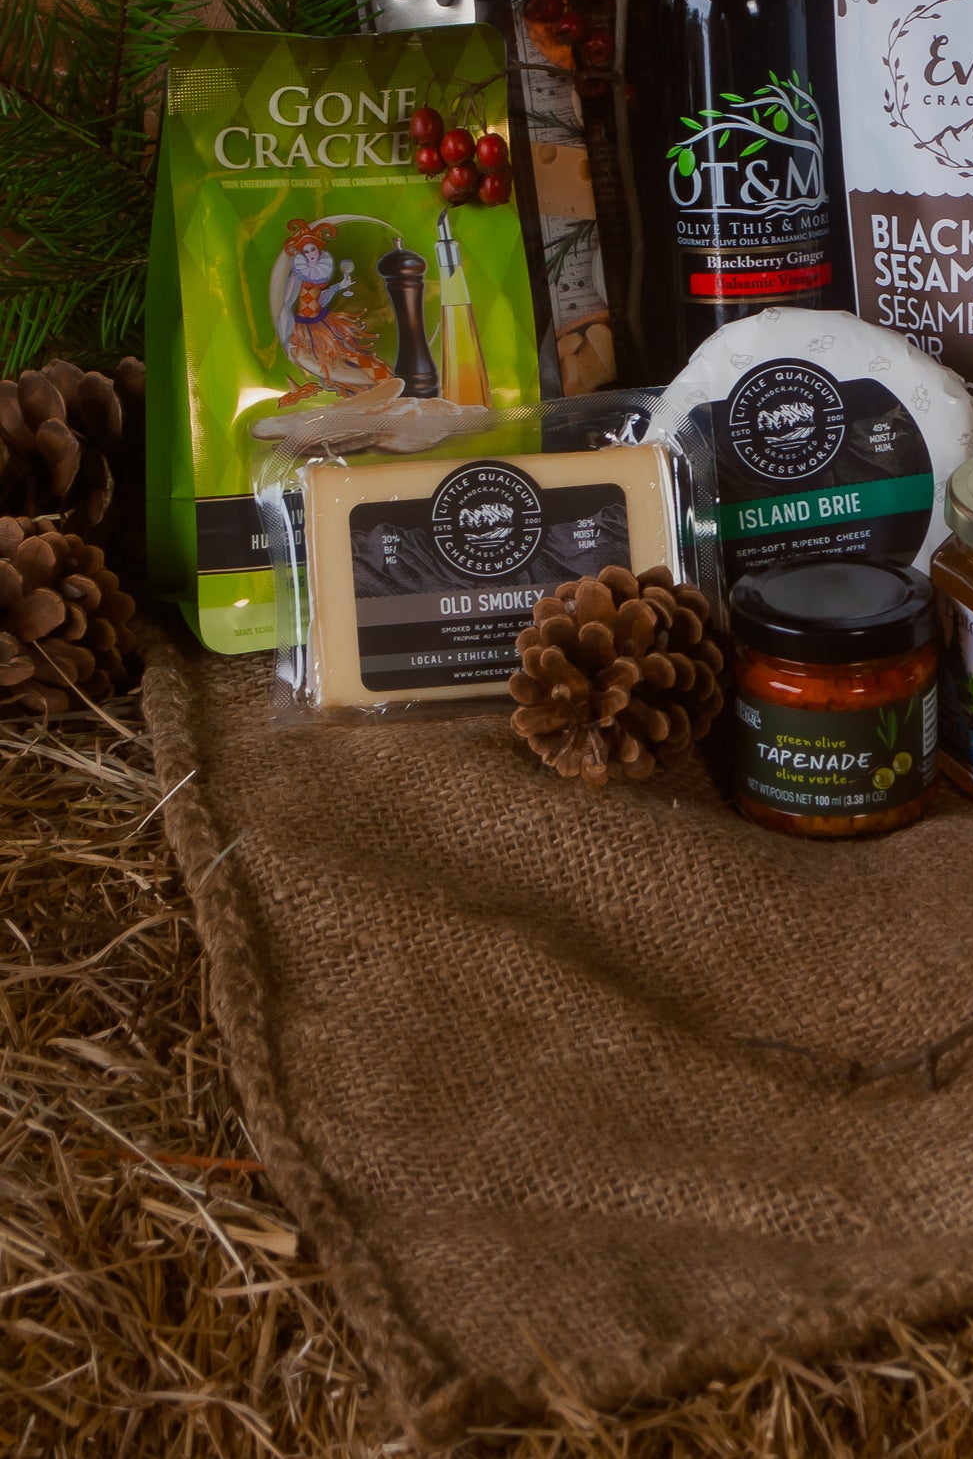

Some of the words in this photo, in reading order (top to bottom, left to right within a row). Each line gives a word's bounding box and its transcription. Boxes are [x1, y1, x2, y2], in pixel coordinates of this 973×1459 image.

[268, 86, 417, 127] GONE
[214, 126, 413, 170] CRACKE
[676, 220, 721, 235] OLIVE
[728, 221, 773, 235] THIS
[781, 218, 793, 232] &
[677, 236, 710, 246] GOURMET
[712, 238, 737, 246] OLIVE
[738, 237, 759, 246] OILS
[761, 237, 769, 245] &
[771, 232, 807, 244] BALSAMIC
[706, 255, 784, 270] Blackberry
[786, 249, 825, 265] Ginger
[735, 378, 767, 418] LITTLE
[775, 372, 835, 404] QUALICUM
[756, 386, 814, 408] HANDCRAFTED
[731, 428, 751, 437] ESTD
[826, 414, 845, 422] 2001
[744, 433, 837, 474] CHEESEWORKS
[764, 439, 818, 460] GRASS-FED
[874, 443, 894, 453] HUM.
[438, 477, 470, 514] LITTLE
[478, 473, 535, 508] QUALICUM
[459, 486, 514, 506] HANDCRAFTED
[738, 500, 812, 531] ISLAND
[818, 492, 862, 518] BRIE
[433, 524, 452, 532] ESTD
[524, 517, 541, 525] 2001
[577, 519, 596, 528] 36%
[381, 534, 400, 544] 30%
[464, 540, 515, 557] GRASS-FED
[578, 540, 598, 549] HUM.
[736, 542, 787, 558] SEMI-SOFT
[791, 536, 831, 548] RIPENED
[836, 529, 872, 542] CHEESE
[386, 556, 397, 565] MG
[445, 534, 533, 571] CHEESEWORKS
[440, 595, 472, 615] OLD
[478, 589, 545, 612] SMOKEY
[441, 625, 471, 634] SMOKED
[411, 654, 443, 666] LOCAL
[457, 650, 501, 662] ETHICAL
[775, 733, 812, 748] green
[815, 736, 848, 749] olive
[757, 742, 873, 772] TAPENADE
[775, 768, 804, 784] olive
[808, 772, 848, 786] verte
[797, 792, 814, 805] NET
[814, 794, 830, 806] 100
[831, 794, 842, 805] ml
[843, 793, 864, 806] (3.38
